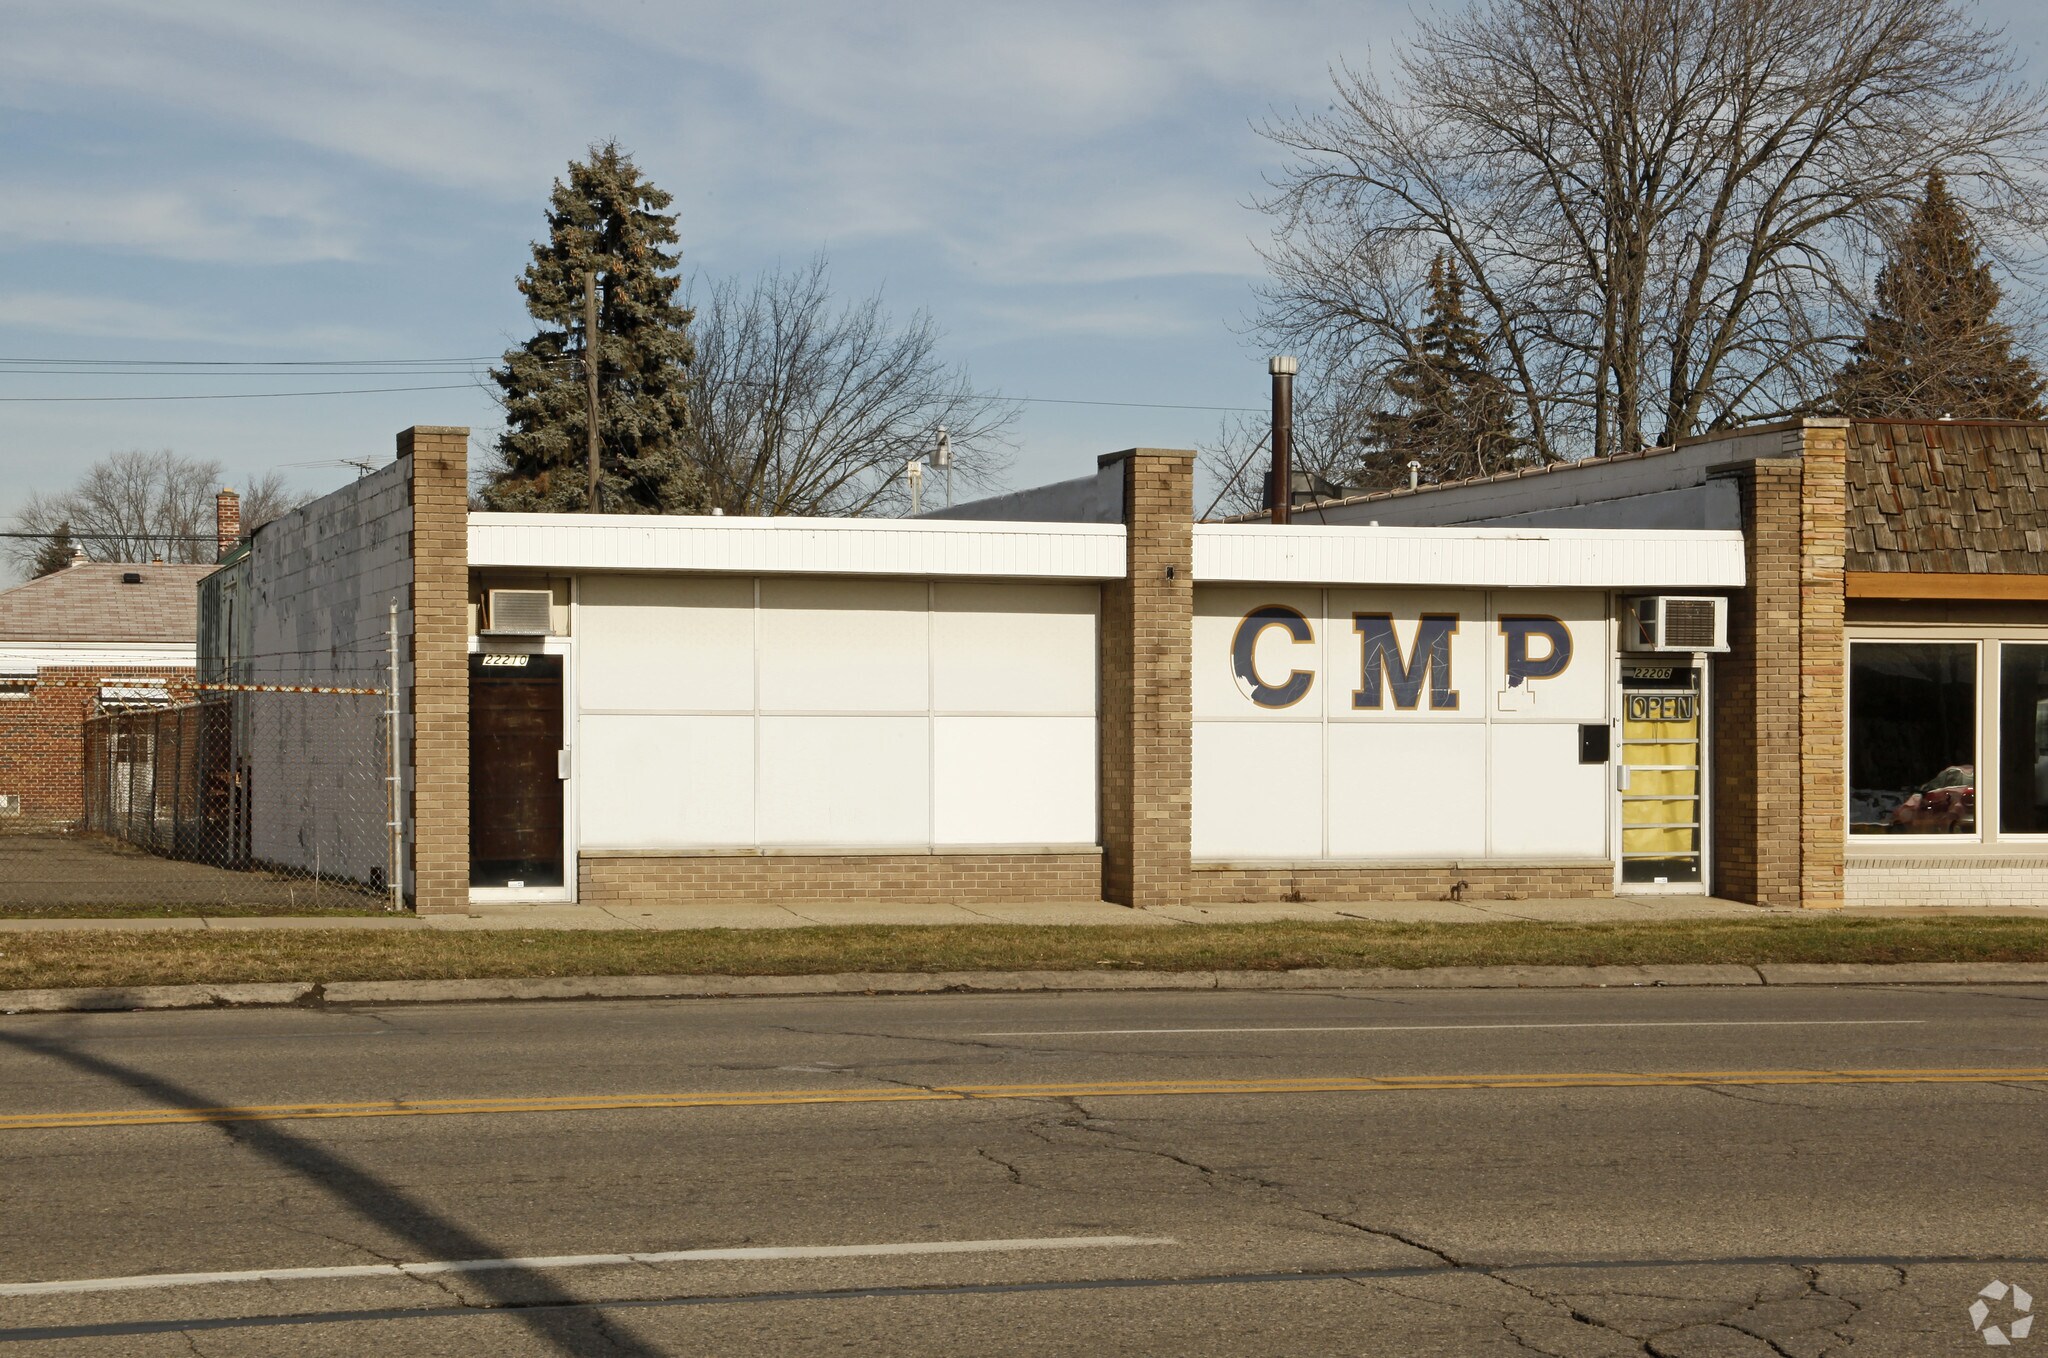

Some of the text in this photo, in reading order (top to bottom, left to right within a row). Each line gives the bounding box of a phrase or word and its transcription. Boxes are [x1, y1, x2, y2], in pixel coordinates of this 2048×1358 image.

[485, 654, 527, 665] 22210
[1634, 668, 1671, 678] 22206
[1632, 696, 1691, 718] OPEN
